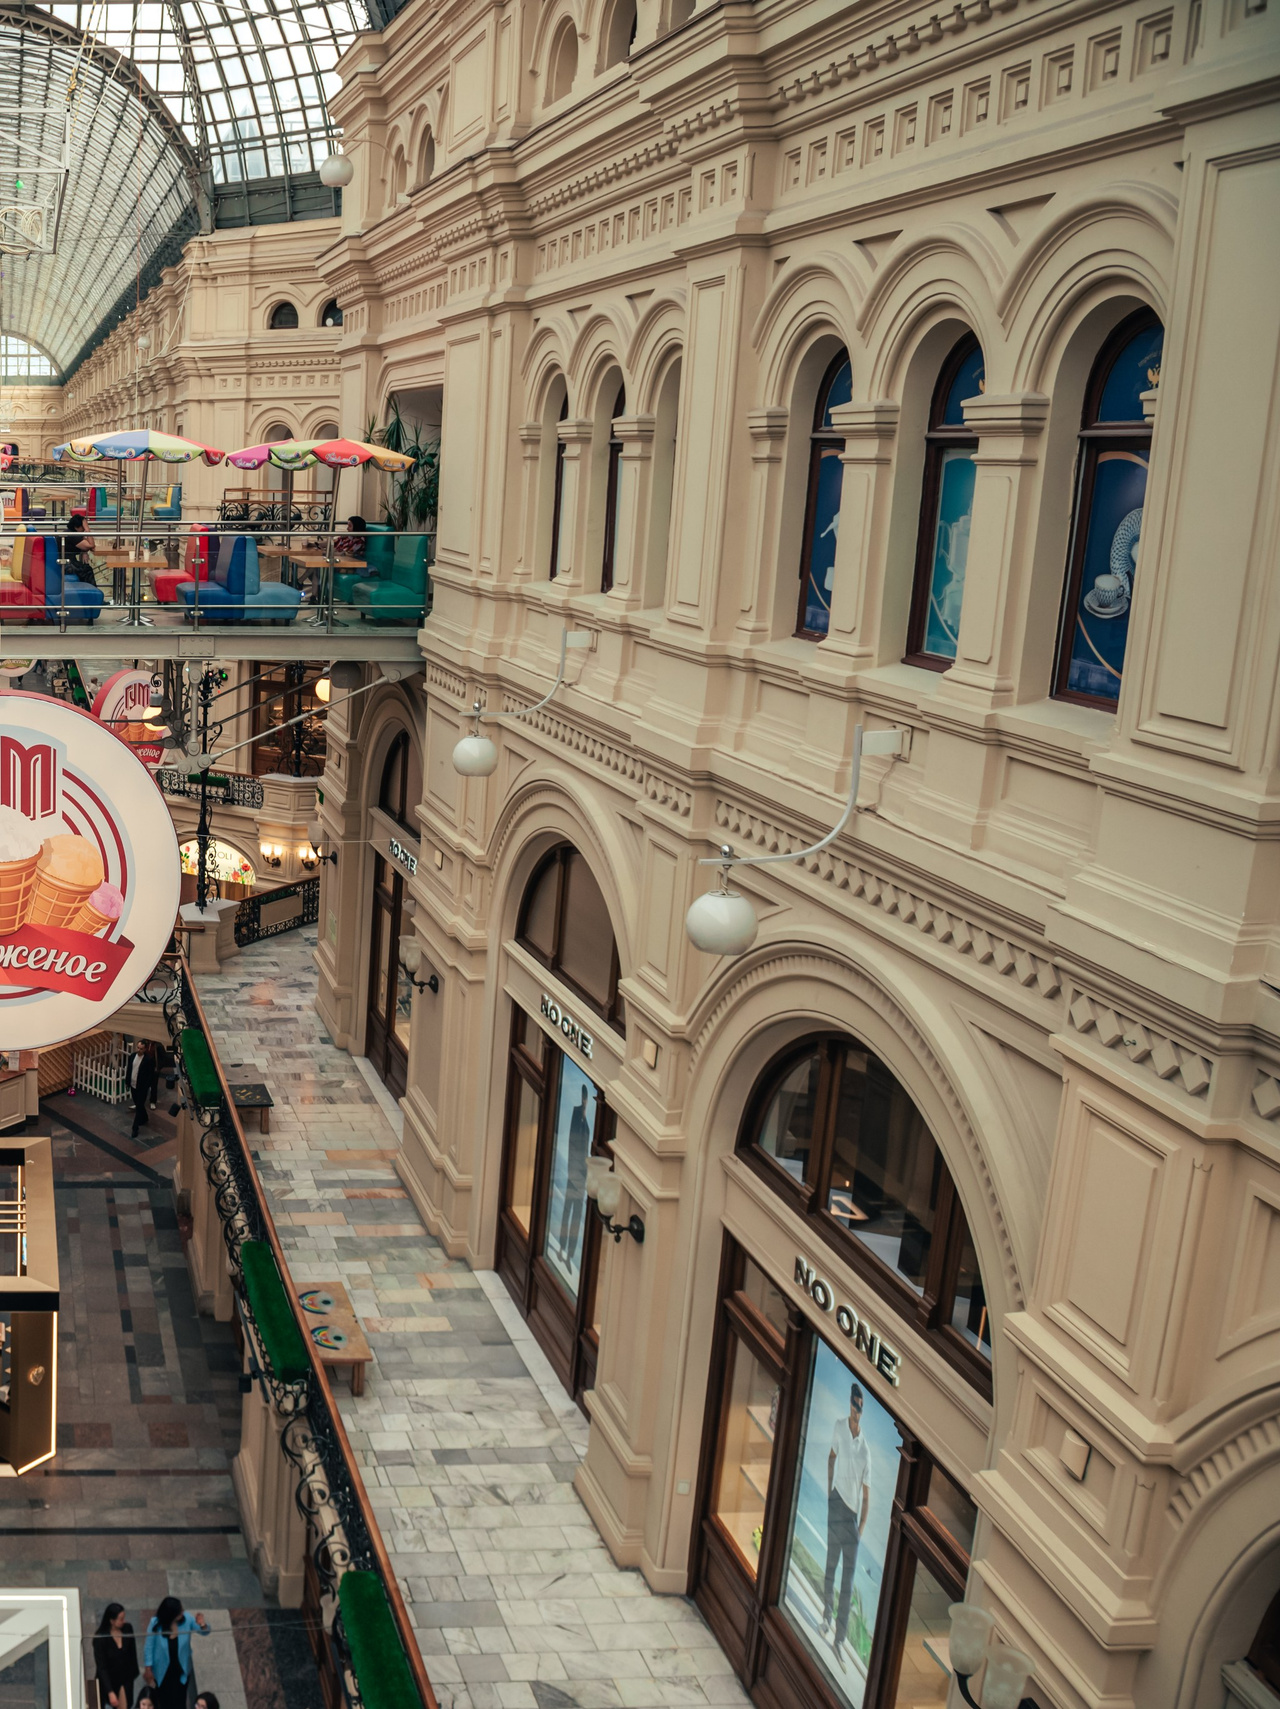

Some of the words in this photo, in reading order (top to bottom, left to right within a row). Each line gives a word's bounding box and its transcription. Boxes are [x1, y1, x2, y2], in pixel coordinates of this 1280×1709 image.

[125, 682, 151, 710] ГУМ
[540, 993, 562, 1027] NO
[561, 1015, 593, 1060] ONE
[794, 1255, 835, 1312] NO
[836, 1304, 901, 1388] ONE
